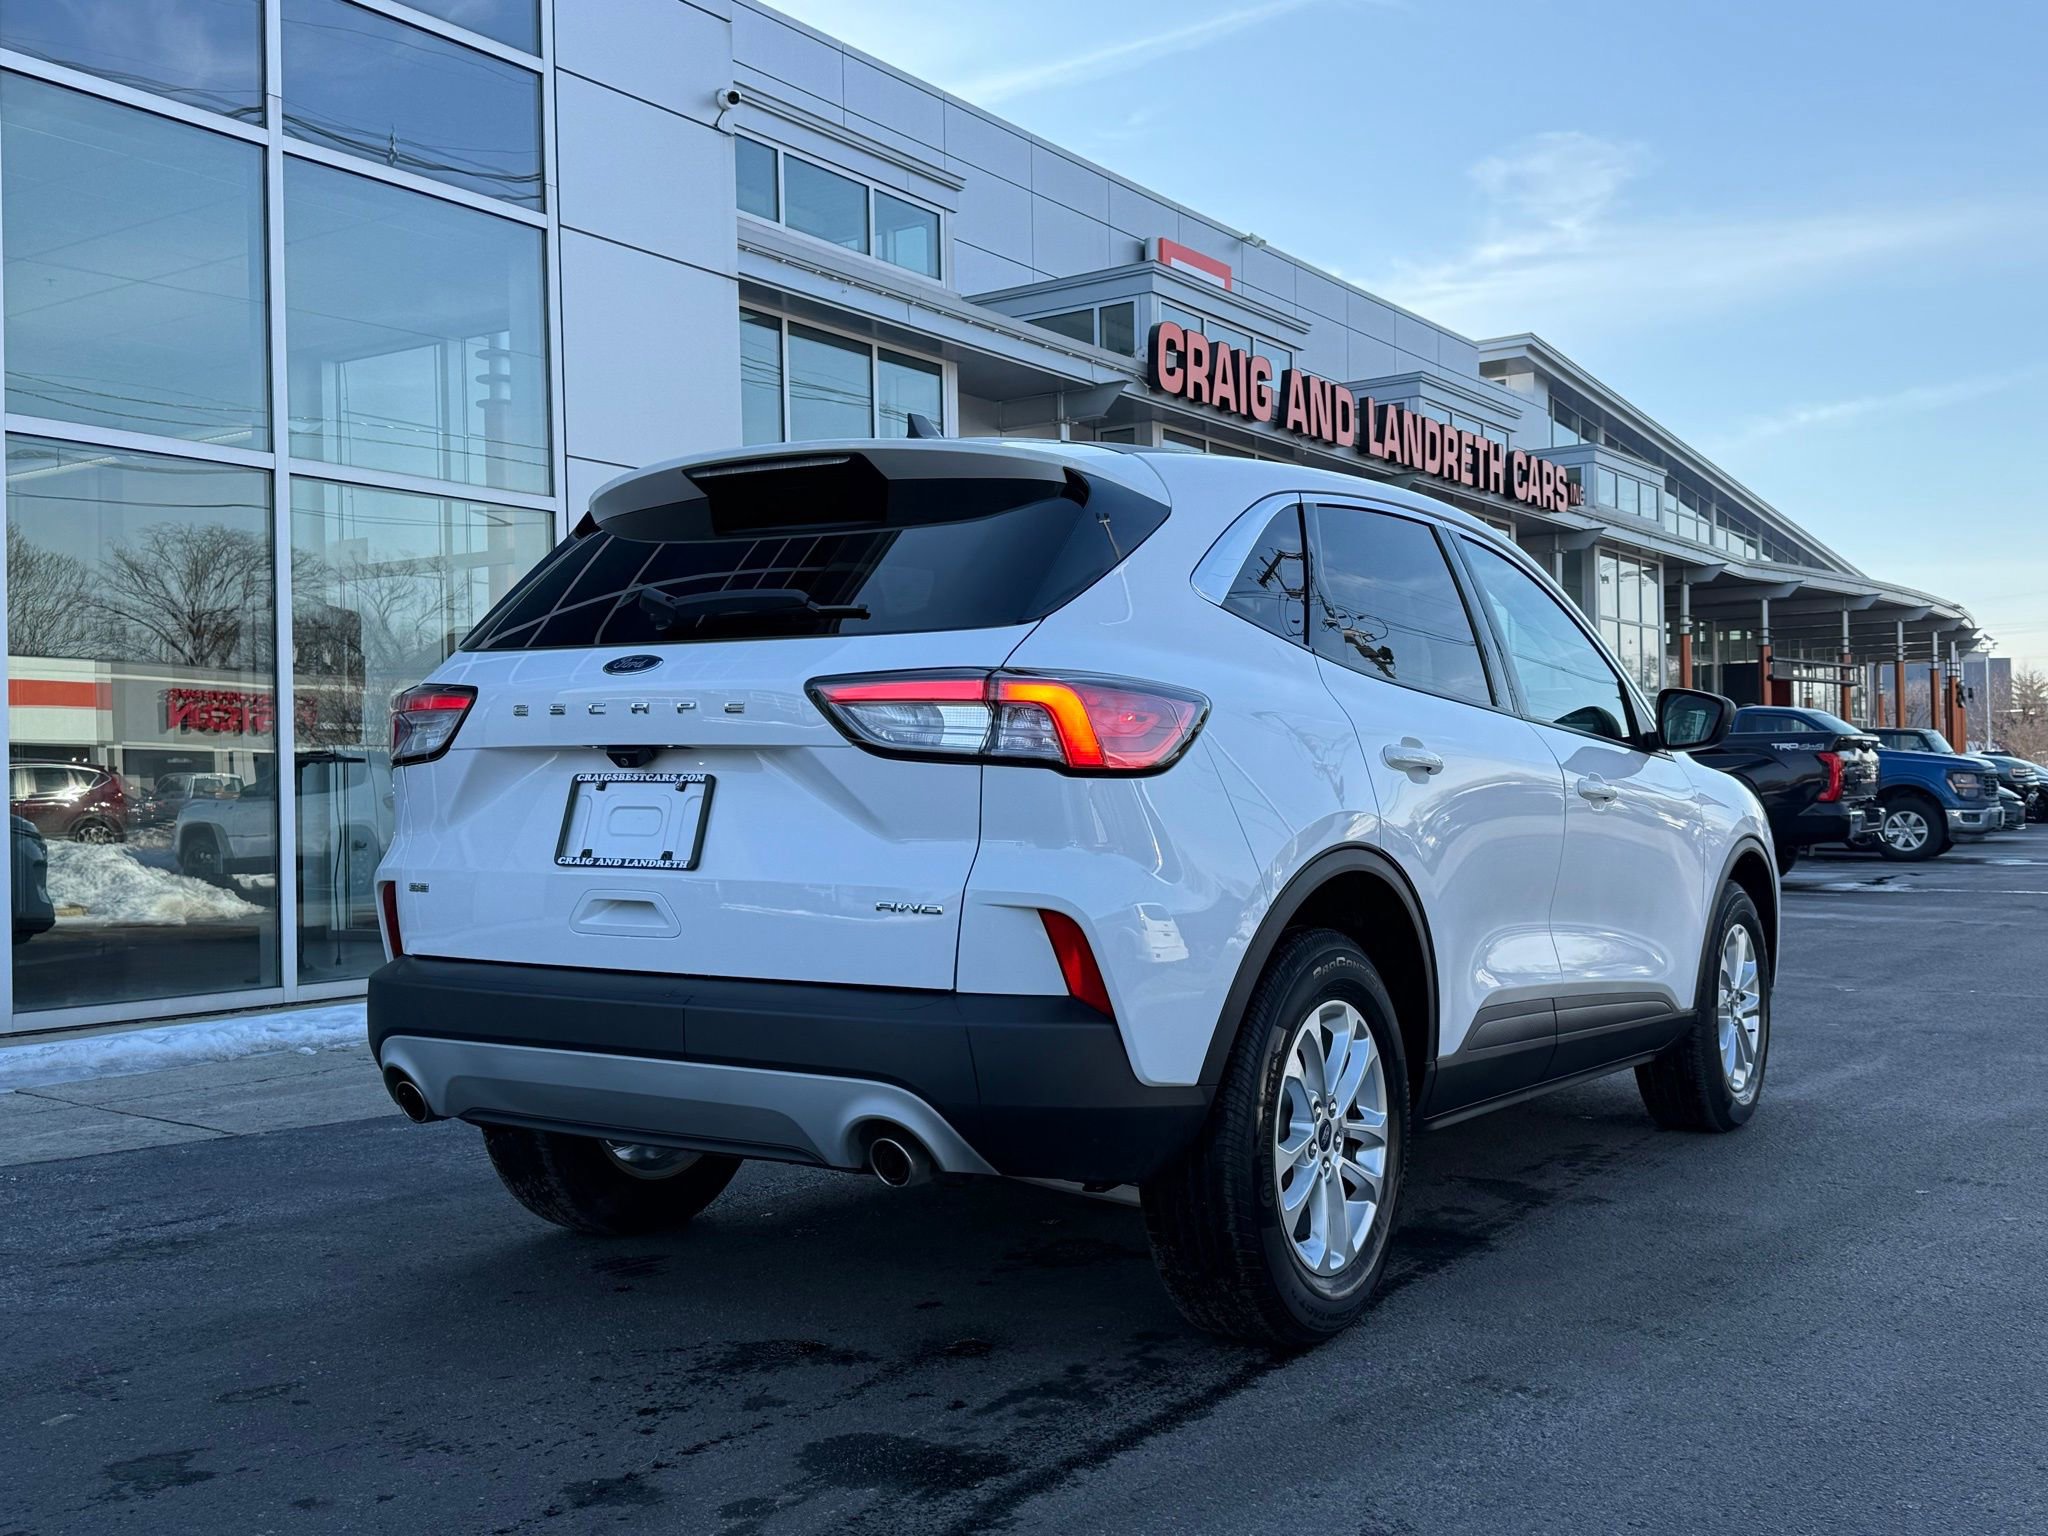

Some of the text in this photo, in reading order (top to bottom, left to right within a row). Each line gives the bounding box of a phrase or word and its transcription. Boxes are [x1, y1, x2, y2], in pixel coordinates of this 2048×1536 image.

[1155, 321, 1274, 423] CRAIG
[1284, 367, 1355, 447] AND
[1367, 396, 1505, 495] LANDRETH
[1512, 449, 1569, 513] CARS
[513, 701, 745, 717] ESCAPE
[576, 773, 706, 783] CRAIGSBESTCARS.COM
[557, 856, 690, 869] CRAIG AND LANDRETH
[875, 902, 943, 915] AWD
